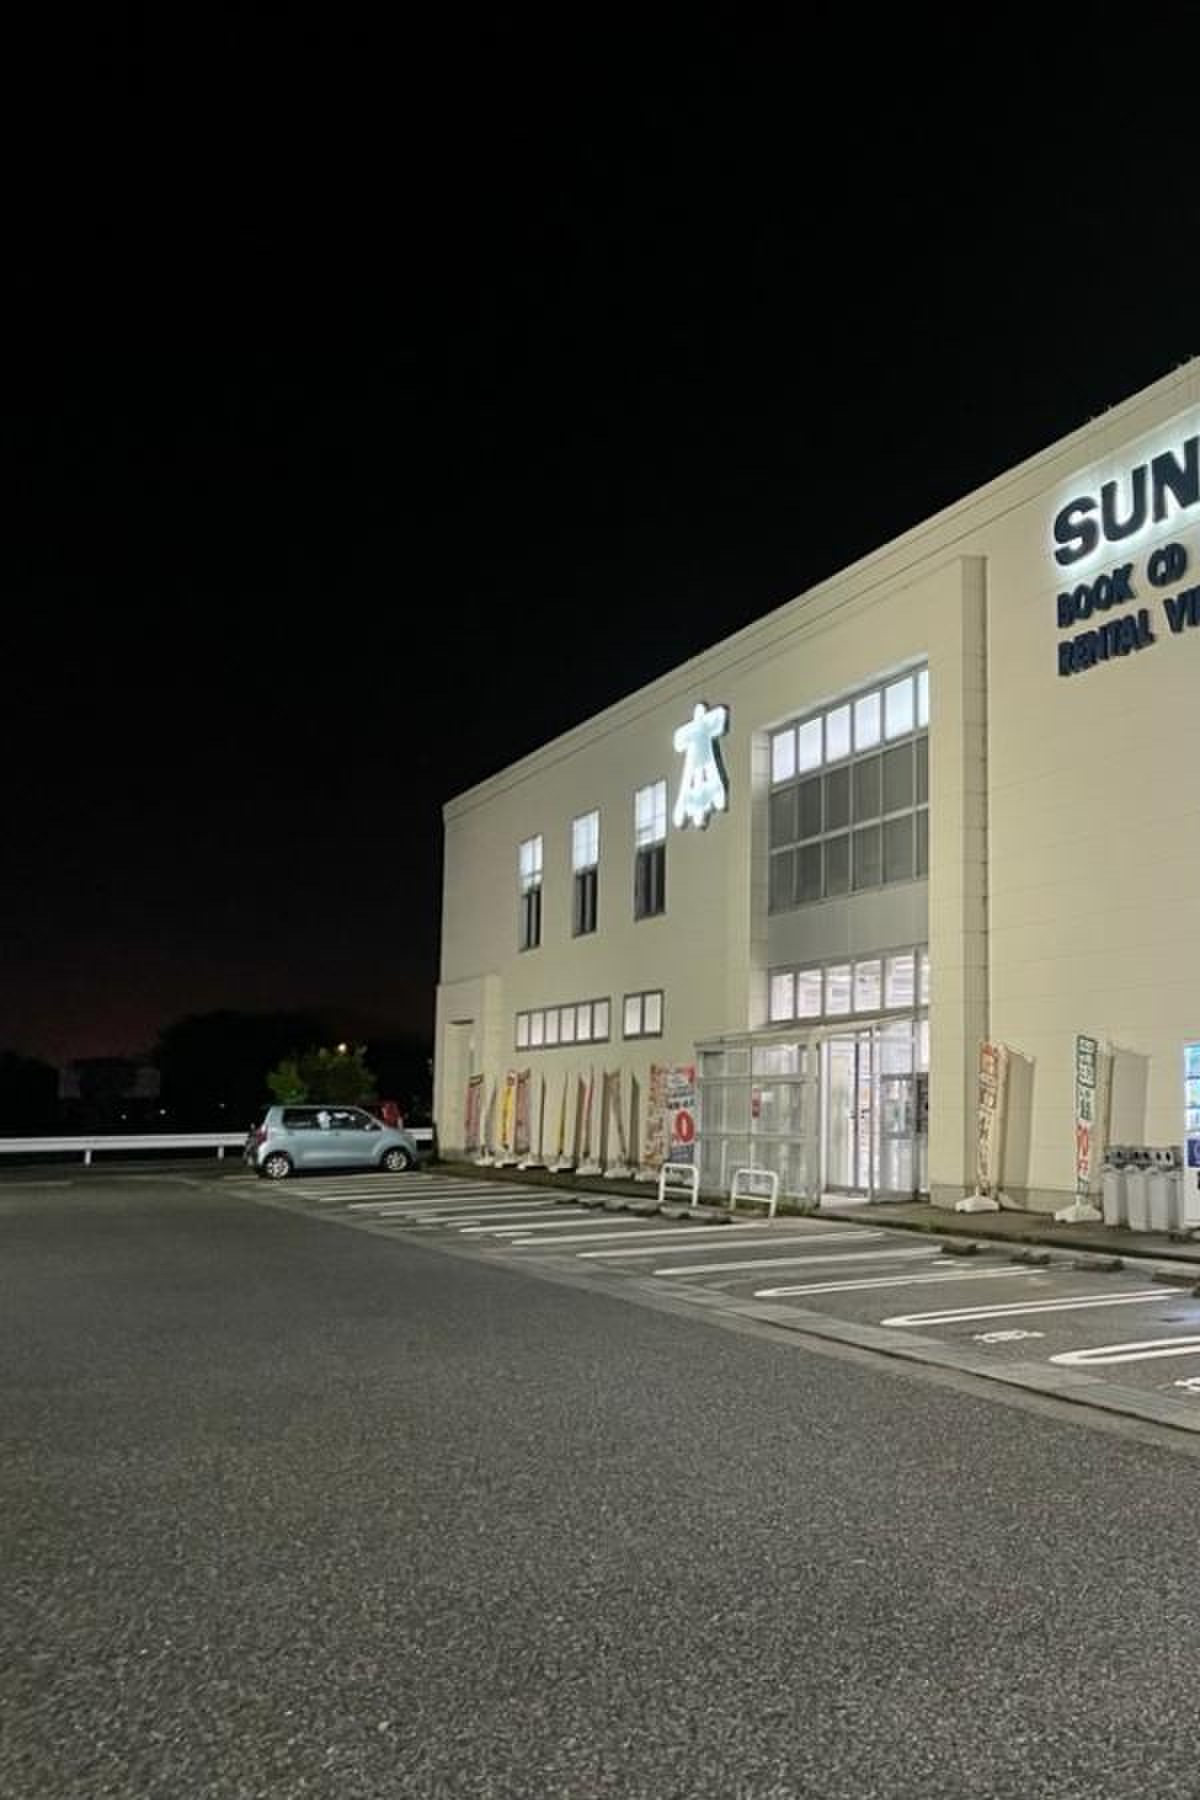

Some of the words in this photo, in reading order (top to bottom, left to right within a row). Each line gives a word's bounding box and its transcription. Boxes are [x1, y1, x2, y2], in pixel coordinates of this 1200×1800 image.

[1057, 562, 1136, 629] BOOK
[1146, 543, 1188, 588] CD
[1057, 608, 1156, 677] RENTAL
